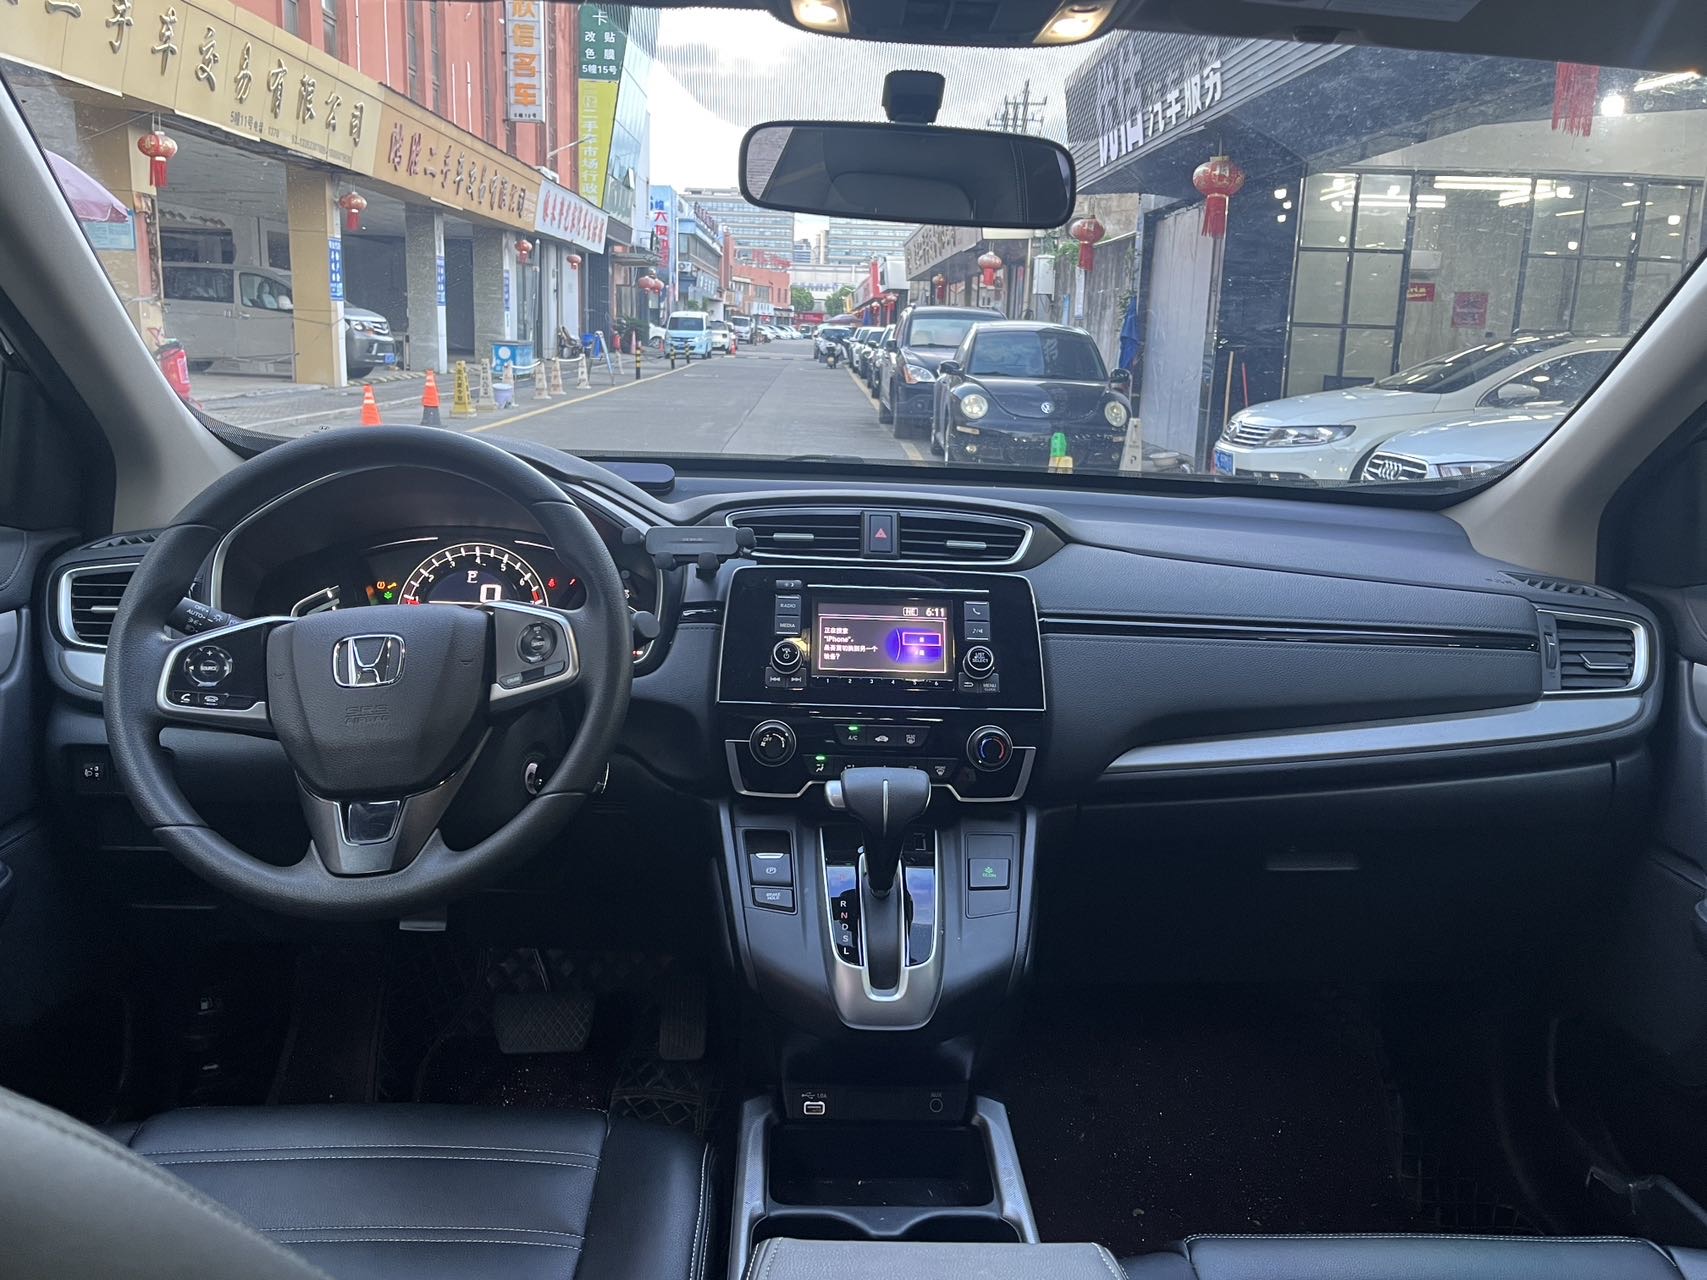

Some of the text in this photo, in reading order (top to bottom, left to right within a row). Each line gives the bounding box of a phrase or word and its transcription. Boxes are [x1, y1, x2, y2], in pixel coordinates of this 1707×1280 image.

[501, 563, 507, 571] 5
[519, 577, 525, 586] 6
[480, 584, 502, 602] 0
[195, 604, 206, 612] OFF
[925, 607, 945, 617] 6:11
[186, 609, 203, 619] AUTO
[841, 923, 849, 931] D
[843, 947, 850, 955] L
